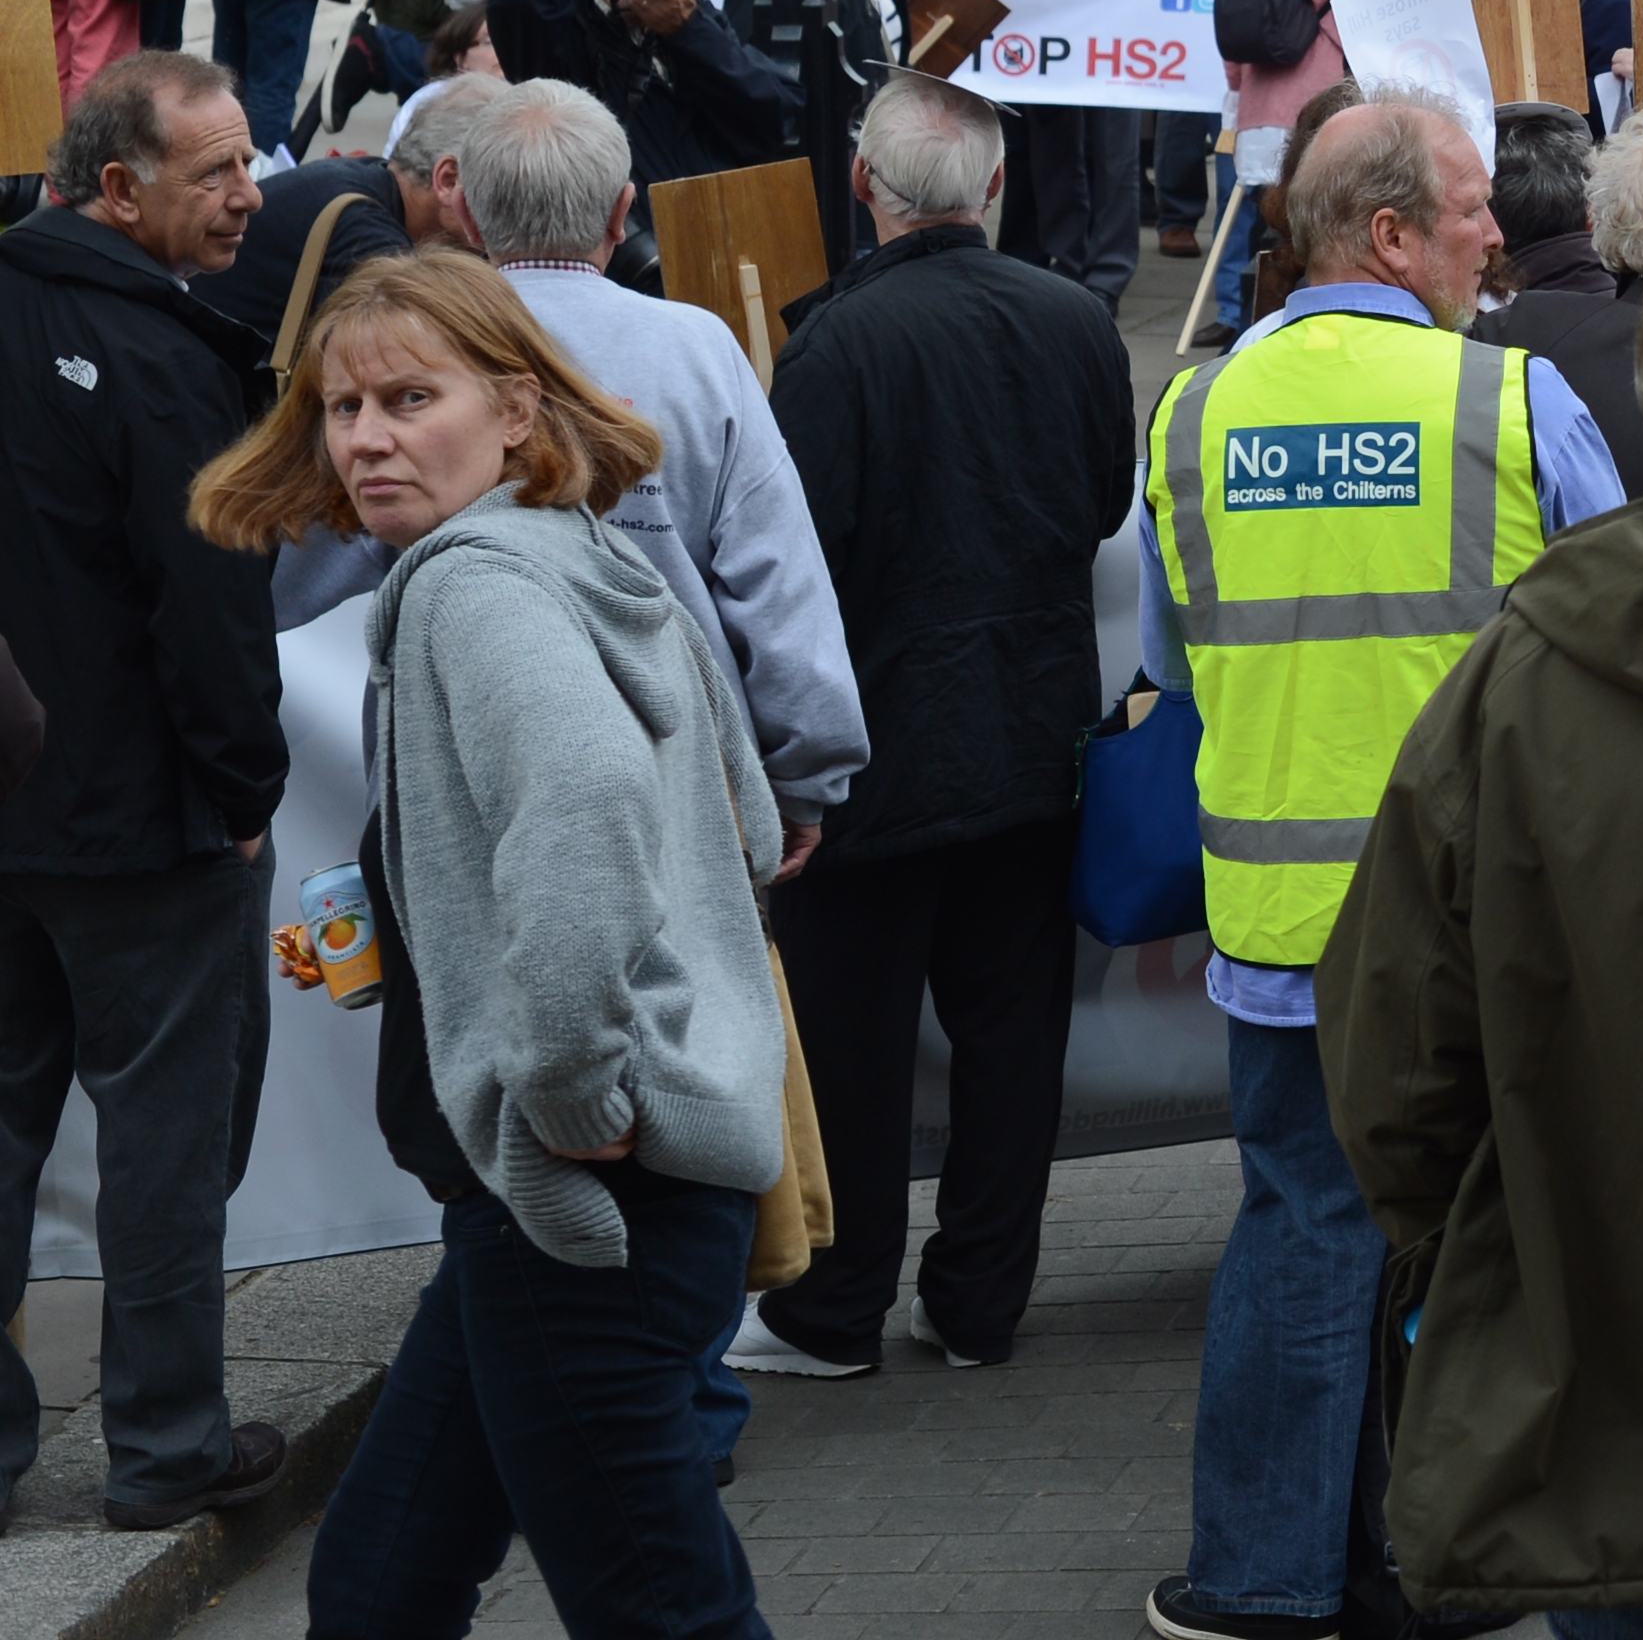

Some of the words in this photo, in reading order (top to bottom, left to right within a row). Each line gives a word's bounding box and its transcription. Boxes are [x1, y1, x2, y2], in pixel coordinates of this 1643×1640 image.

[1086, 37, 1187, 82] HS2
[1227, 436, 1289, 479] No
[1317, 431, 1416, 476] HS2
[1227, 486, 1287, 504] across
[1295, 482, 1323, 501] the
[1333, 480, 1416, 501] Chilterns
